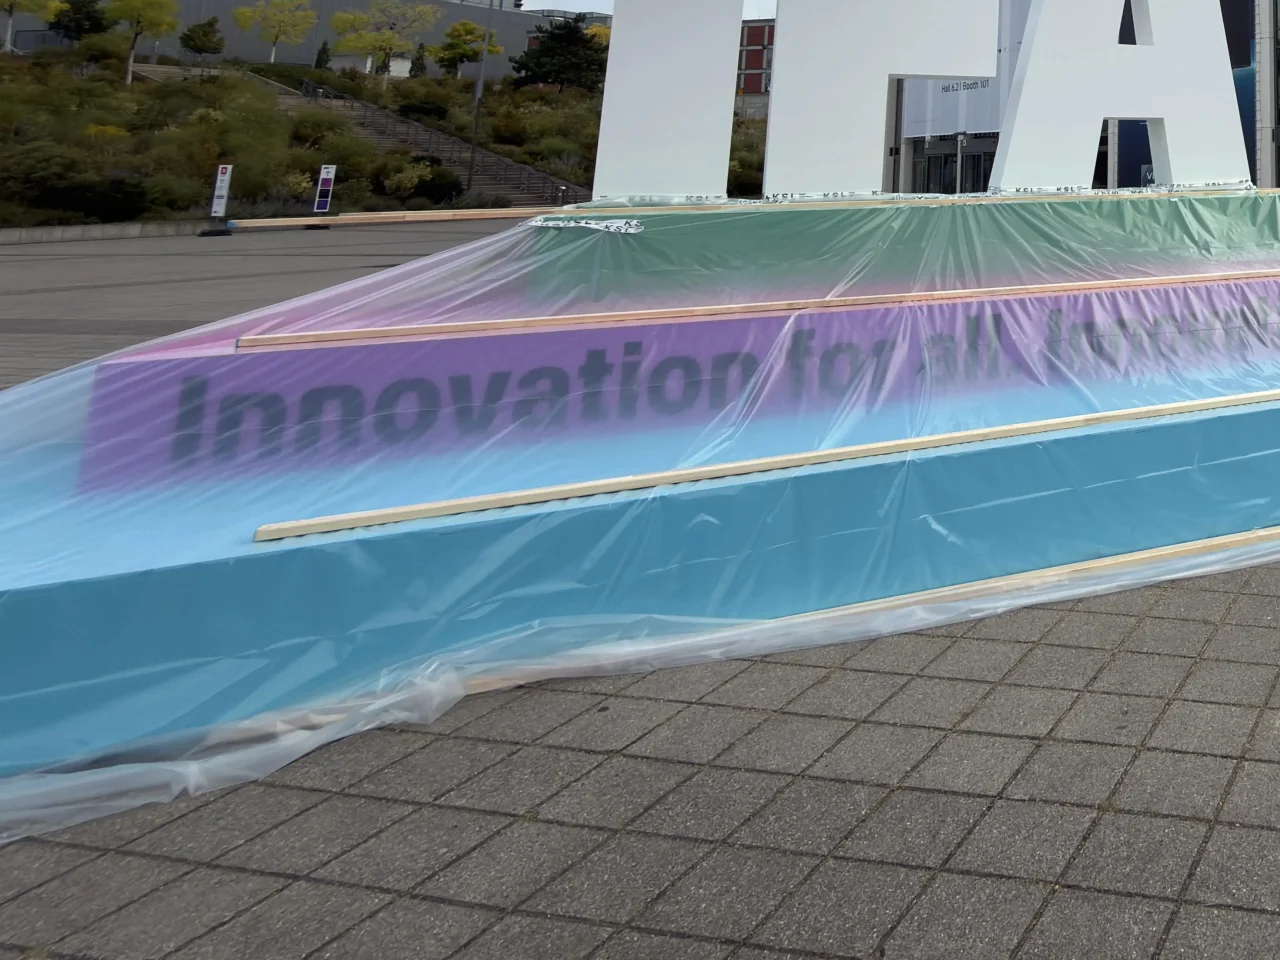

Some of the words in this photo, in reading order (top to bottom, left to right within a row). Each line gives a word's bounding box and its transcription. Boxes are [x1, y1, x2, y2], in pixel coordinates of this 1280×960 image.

[941, 83, 951, 93] Hall
[962, 80, 979, 91] Booth
[980, 79, 990, 89] 101
[168, 338, 759, 464] Innovation
